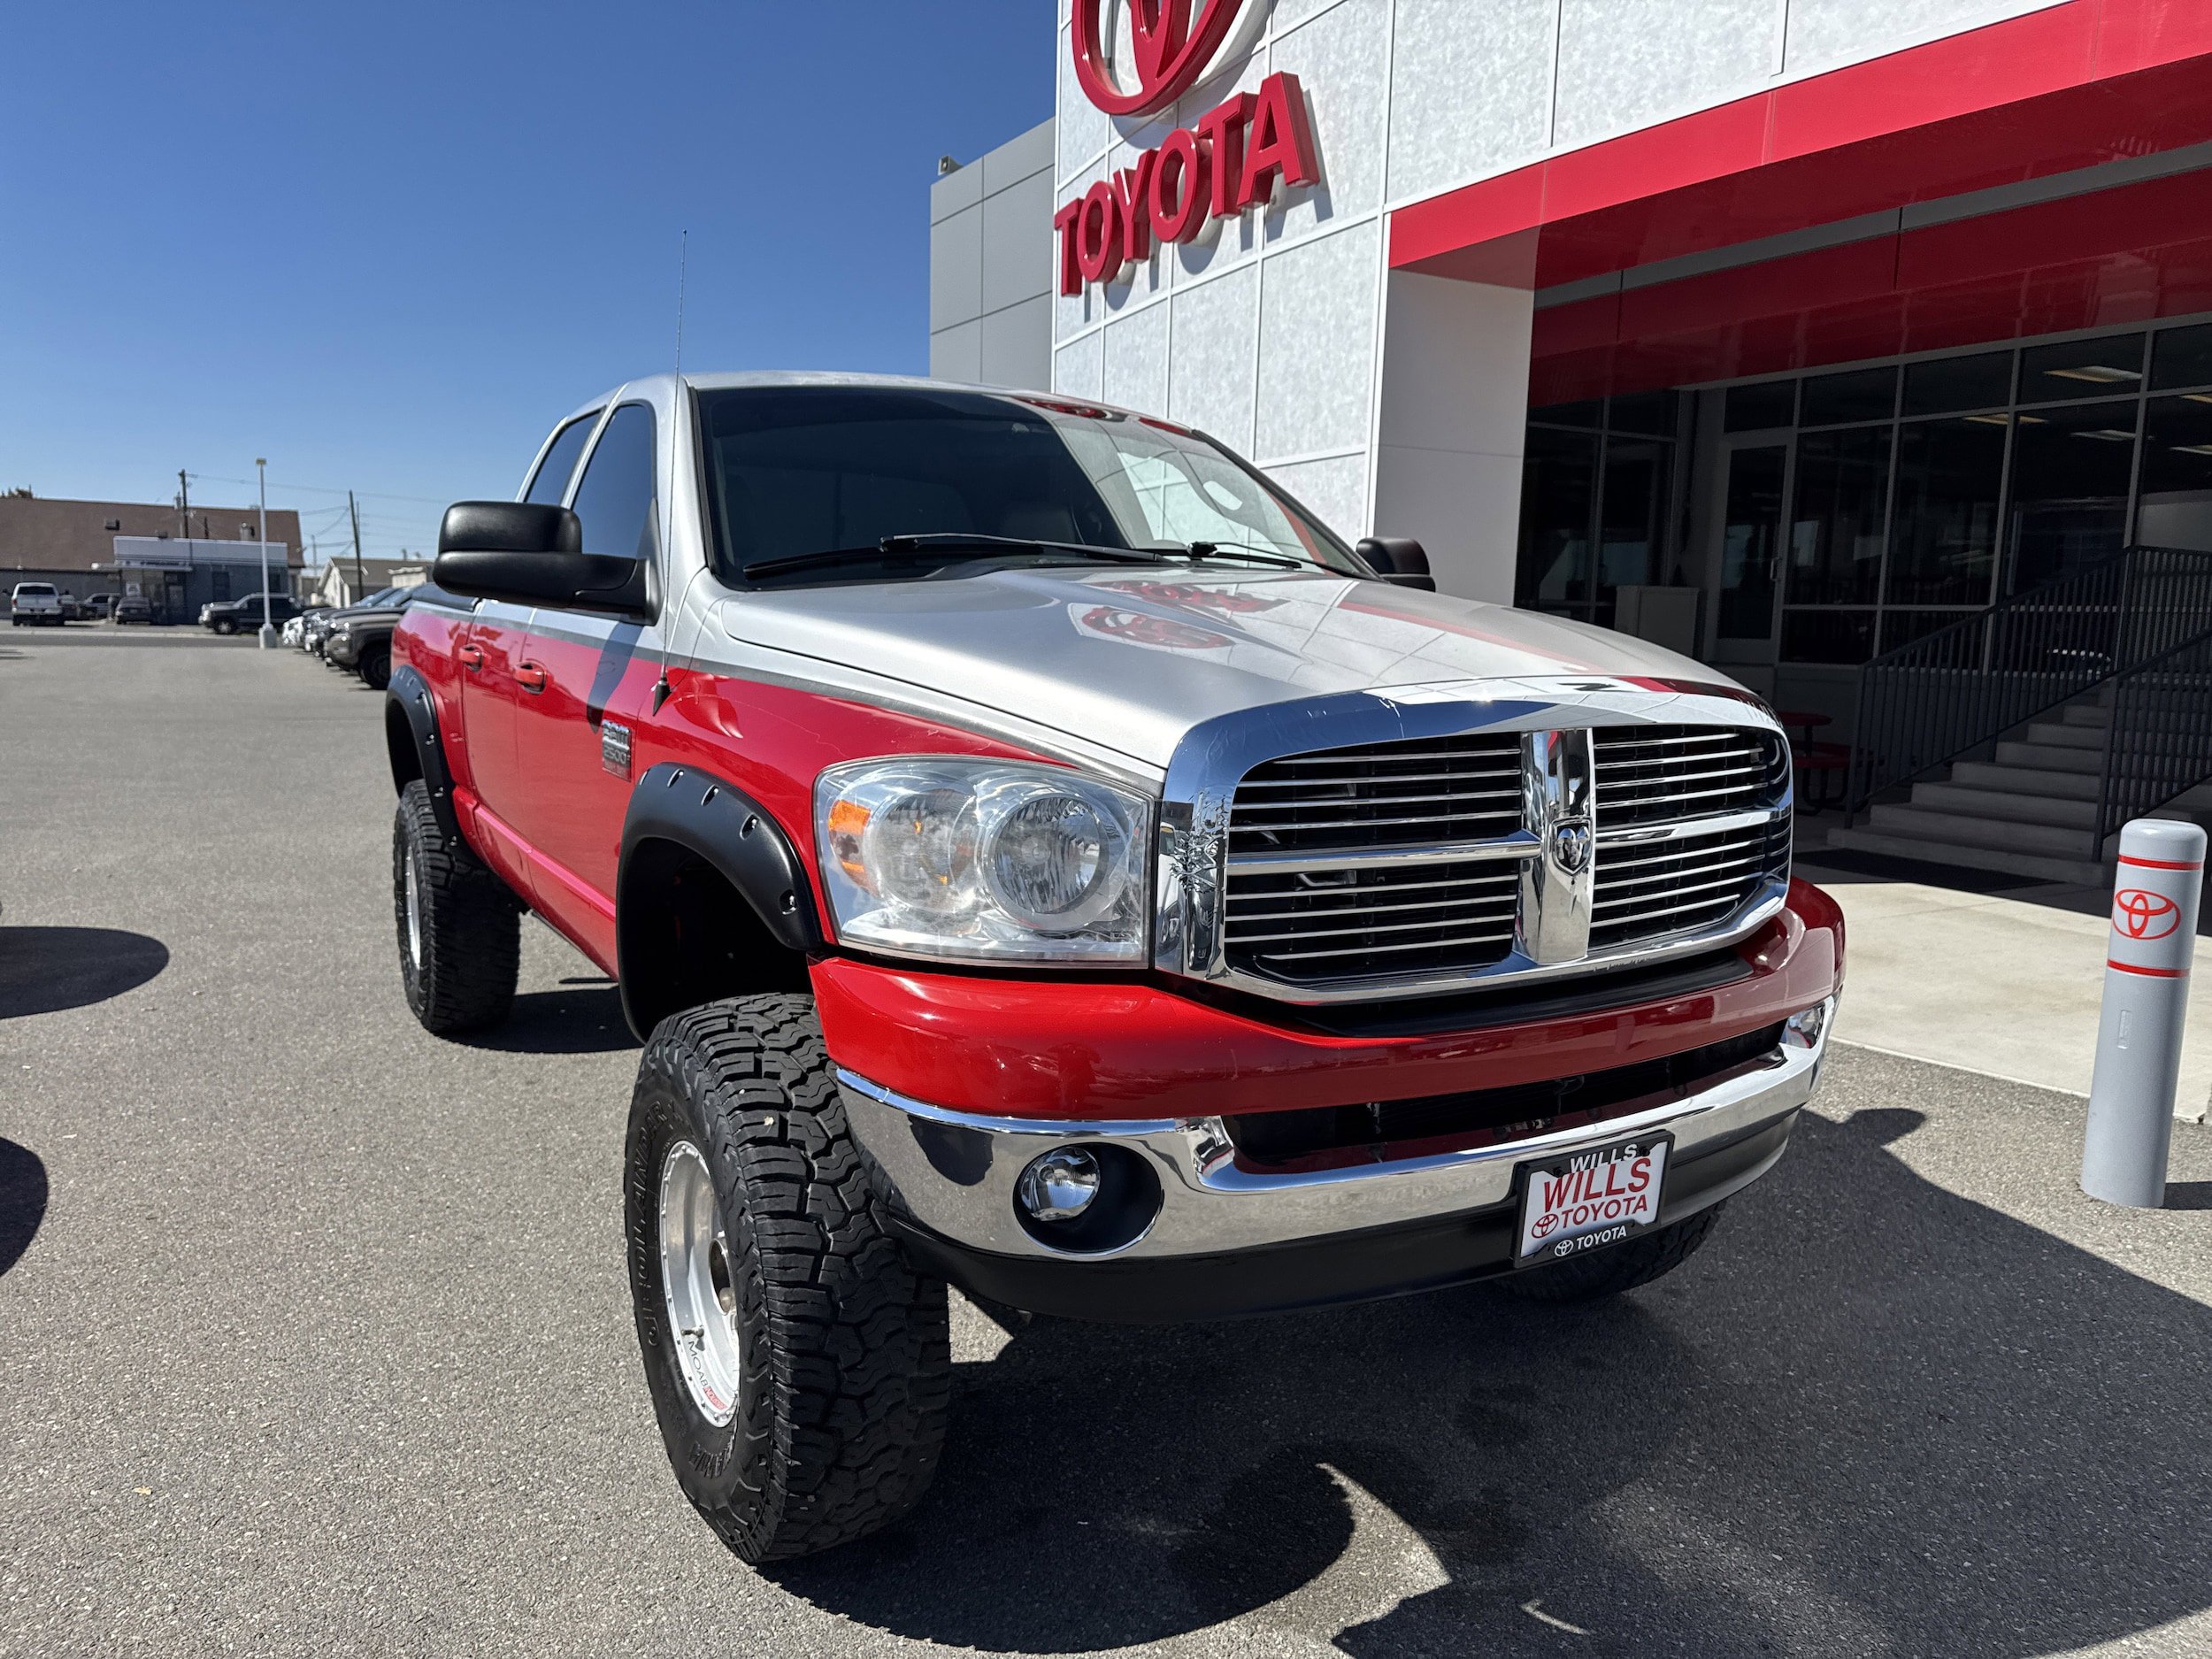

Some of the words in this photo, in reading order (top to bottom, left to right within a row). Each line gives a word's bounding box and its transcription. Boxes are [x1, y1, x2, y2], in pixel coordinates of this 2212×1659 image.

[1054, 71, 1319, 297] TOYOTA
[1570, 1143, 1638, 1173] WILLS
[1543, 1157, 1651, 1213] WILLS
[1562, 1194, 1647, 1228] TOYOTA
[1577, 1225, 1627, 1250] TOYOTA
[688, 1340, 709, 1387] MOAB
